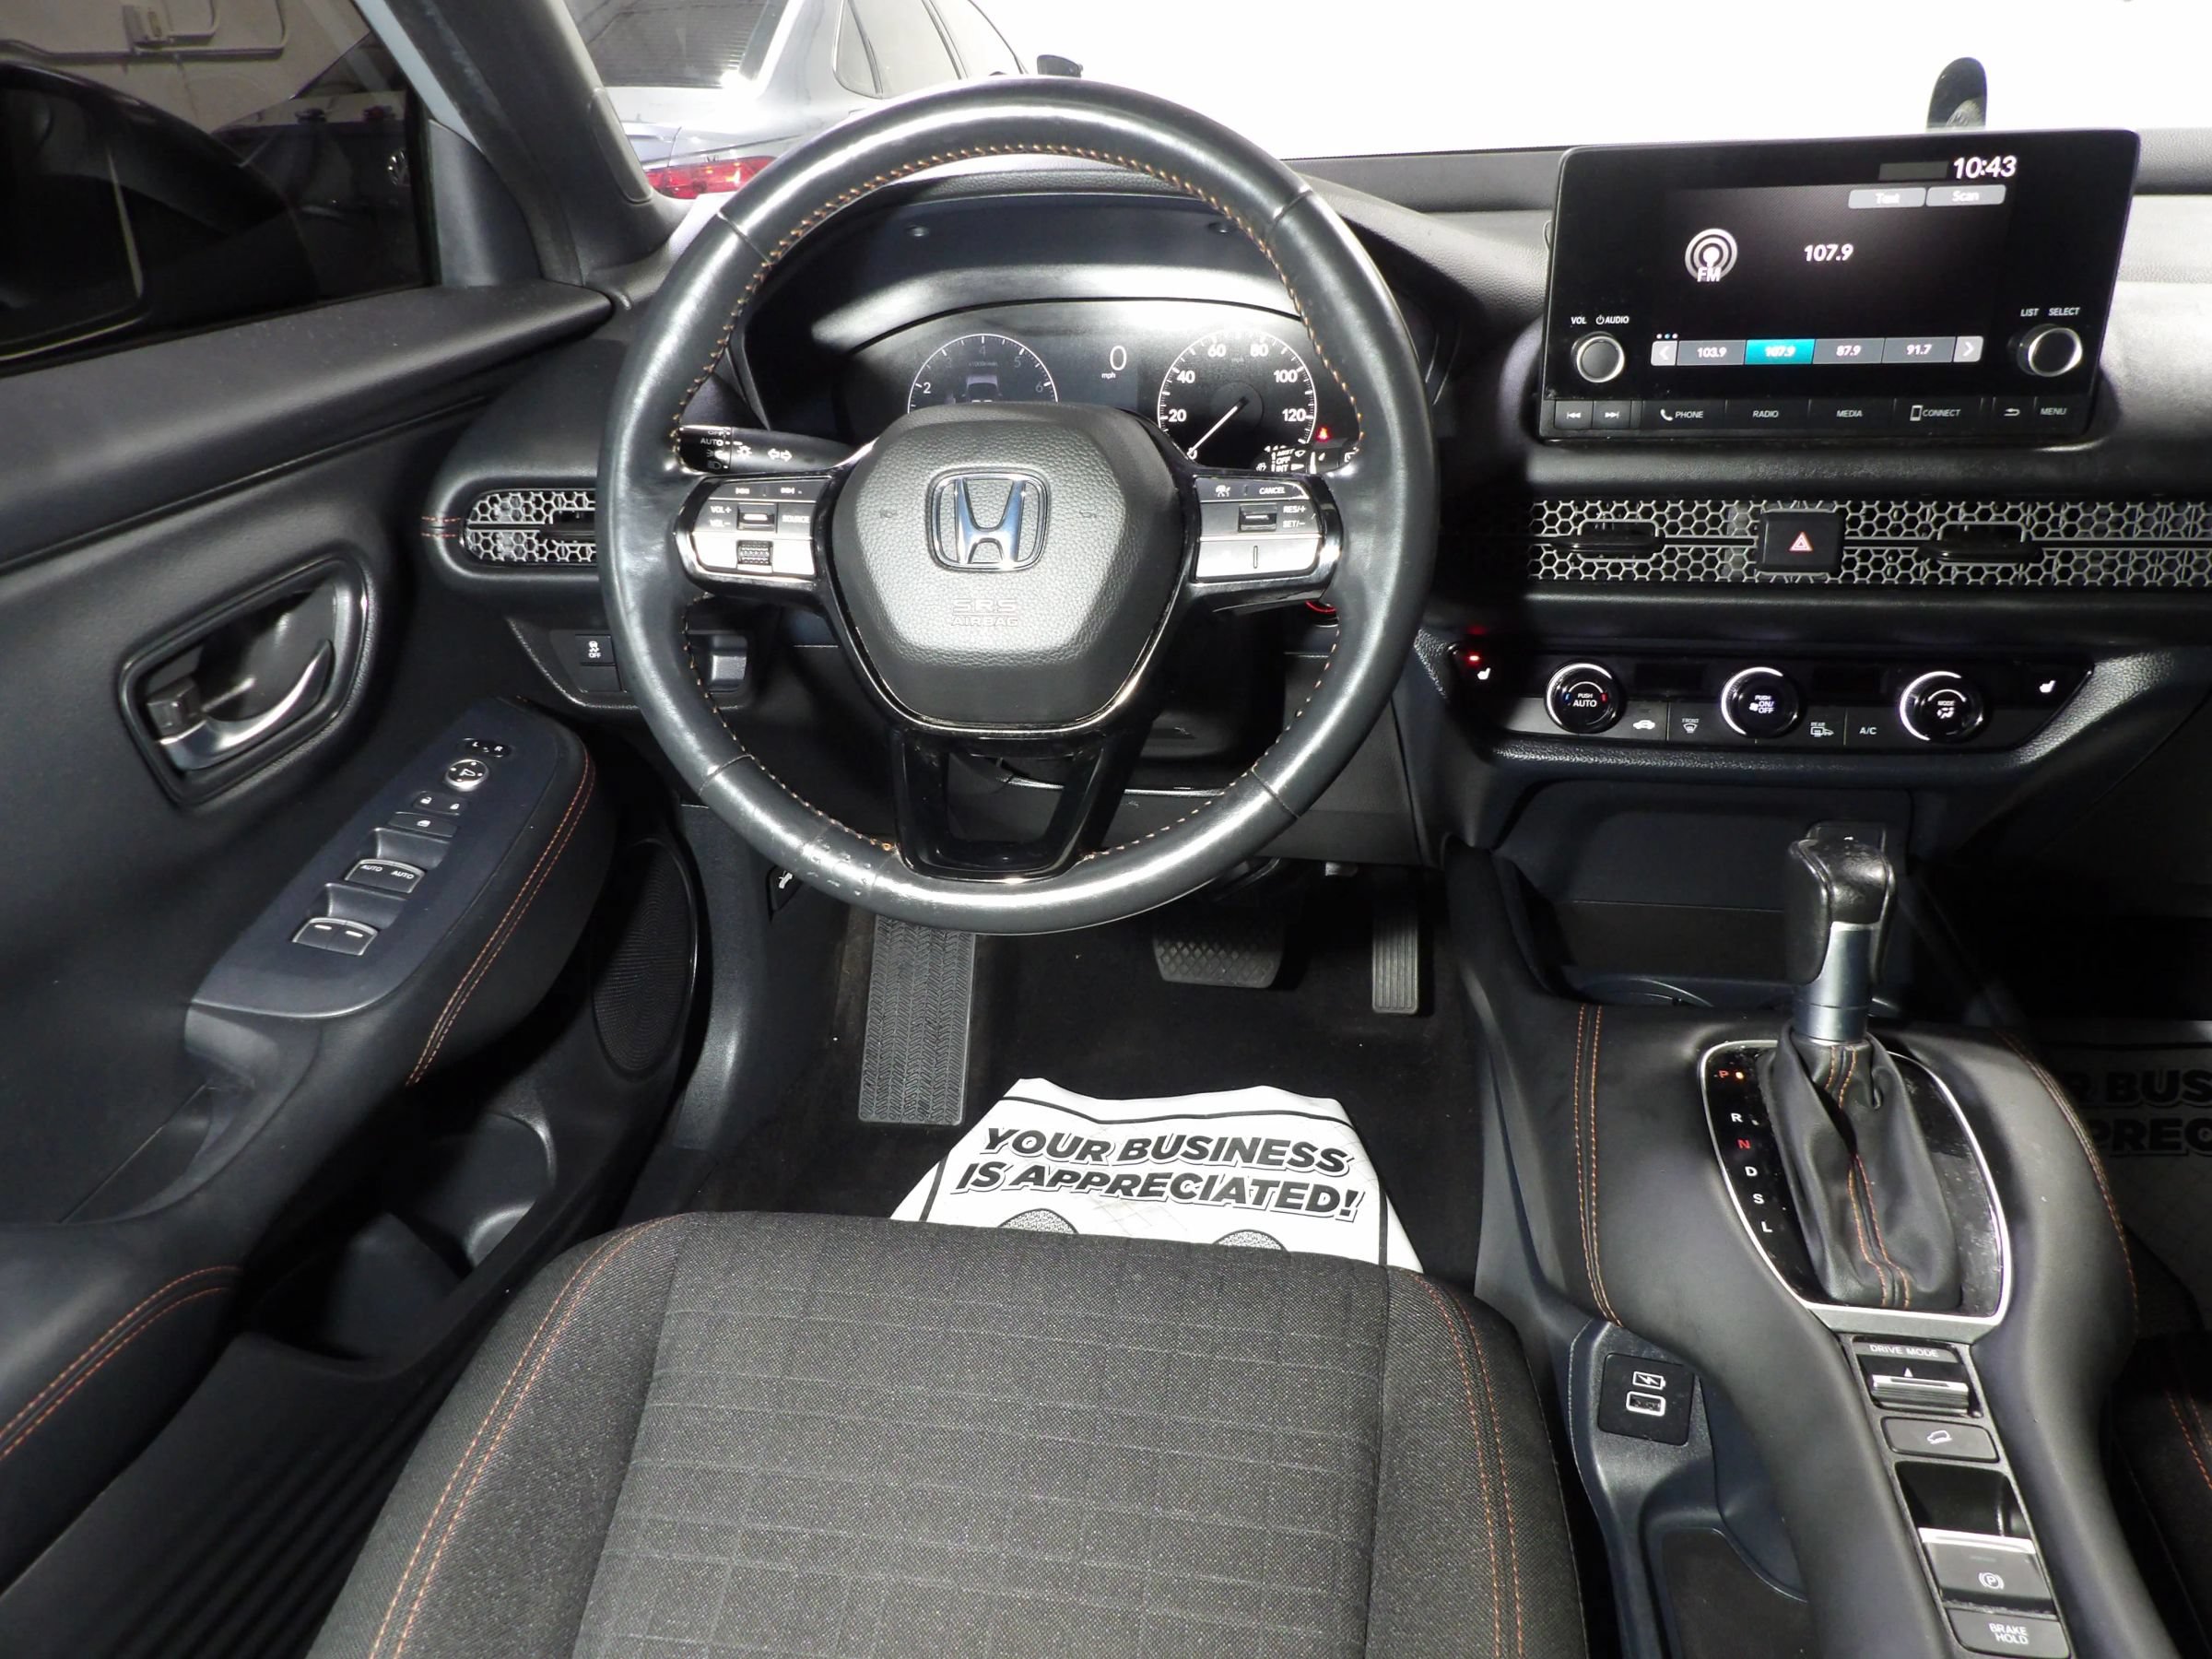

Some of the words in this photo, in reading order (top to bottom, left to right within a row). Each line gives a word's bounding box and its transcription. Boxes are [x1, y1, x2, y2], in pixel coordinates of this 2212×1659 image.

[1953, 155, 2018, 180] 10:43
[1951, 190, 1980, 202] Scan
[1803, 242, 1854, 262] 107.9
[1697, 266, 1722, 283] FM
[2019, 308, 2040, 317] LIST
[2048, 307, 2081, 317] SELECT
[1571, 316, 1587, 324] VOL
[1605, 315, 1630, 324] AUDIO
[979, 345, 986, 356] 4
[1207, 344, 1227, 358] 60
[1250, 343, 1269, 358] 80
[1696, 347, 1727, 359] 103.9
[1835, 345, 1862, 357] 87.9
[1905, 344, 1933, 356] 91.7
[1014, 356, 1022, 369] 5
[1109, 345, 1127, 371] 0
[1176, 370, 1196, 384] 40
[1273, 369, 1299, 383] 100
[923, 382, 932, 394] 2
[1035, 382, 1043, 393] 6
[1168, 408, 1187, 423] 20
[1282, 408, 1307, 422] 120
[1675, 410, 1704, 419] PHONE
[1752, 409, 1779, 418] RADIO
[1836, 408, 1864, 418] MEDIA
[1923, 408, 1961, 418] CONNECT
[2040, 406, 2067, 416] MENU
[700, 438, 724, 447] AUTO
[1276, 456, 1291, 465] OFF
[1276, 465, 1288, 473] INT
[1258, 487, 1287, 495] CANCEL
[952, 597, 1018, 613] SRS
[950, 616, 1018, 628] AIRBAG
[1572, 700, 1597, 708] AUTO
[1859, 726, 1877, 735] A/C
[360, 865, 383, 873] AUTO
[391, 870, 415, 879] AUTO
[1718, 1070, 1729, 1078] P
[1730, 1112, 1744, 1124] R
[1737, 1138, 1751, 1150] N
[983, 1127, 1112, 1164] YOUR
[1116, 1132, 1354, 1174] BUSINESS
[1745, 1166, 1759, 1177] D
[956, 1161, 1007, 1191] IS
[1009, 1164, 1365, 1218] APPRECIATED!
[1752, 1193, 1765, 1205] S
[1761, 1221, 1773, 1233] L
[1869, 1343, 1903, 1356] DRIVE
[1906, 1347, 1940, 1359] MODE
[1989, 1622, 2029, 1637] BRAKE
[1994, 1631, 2029, 1645] HOLD
